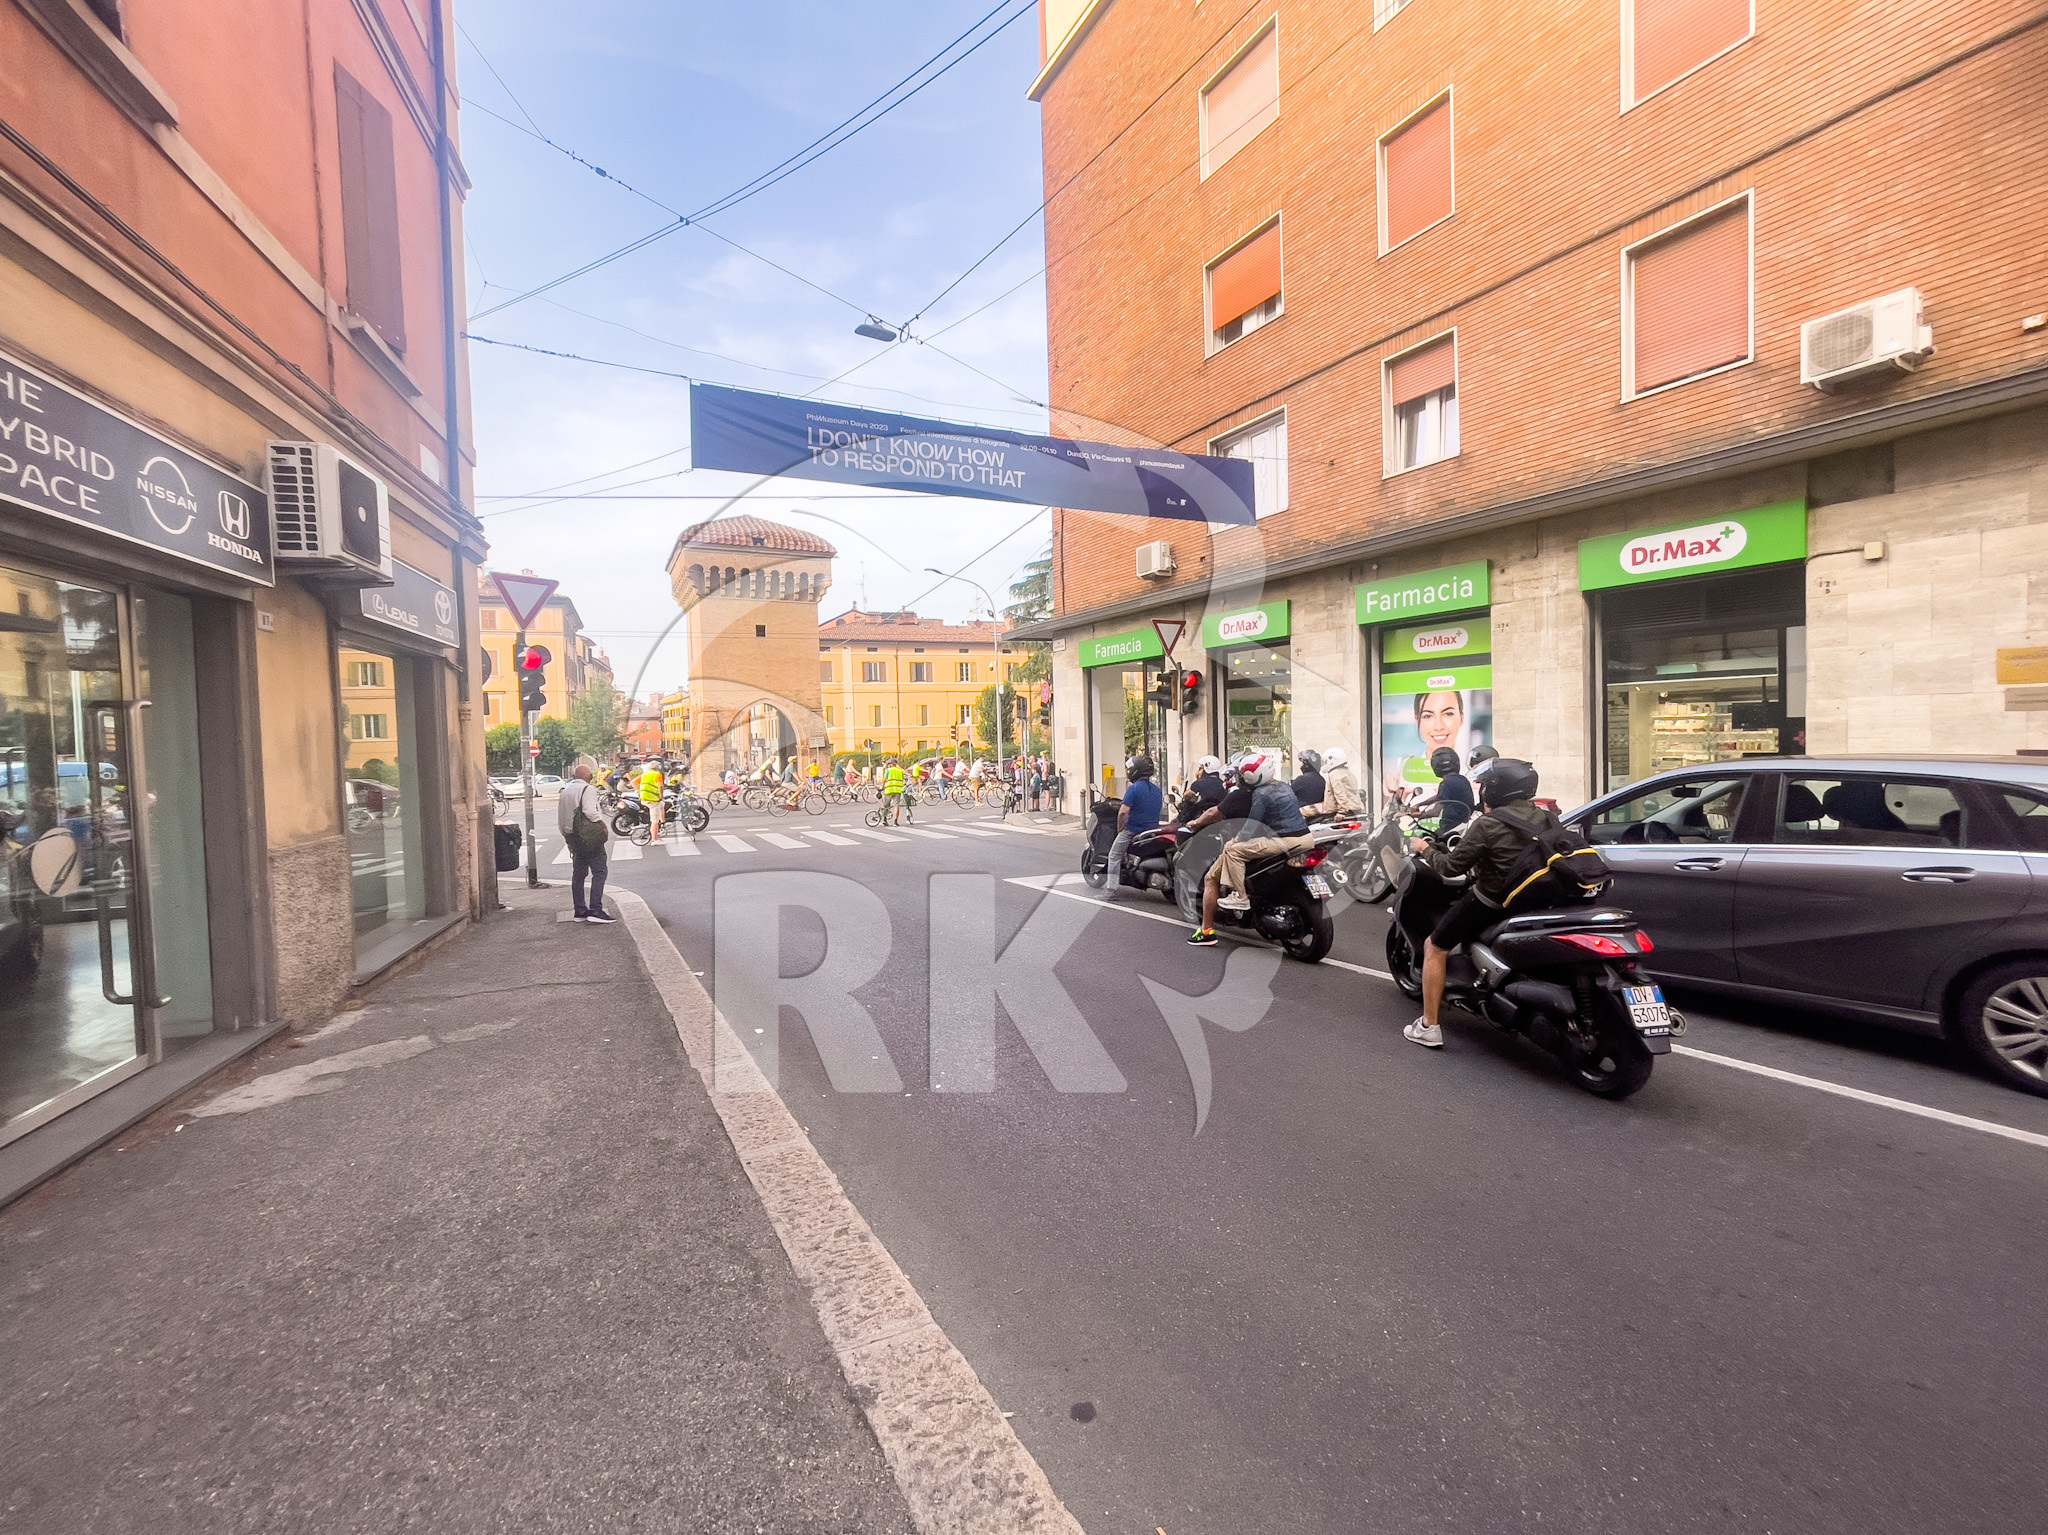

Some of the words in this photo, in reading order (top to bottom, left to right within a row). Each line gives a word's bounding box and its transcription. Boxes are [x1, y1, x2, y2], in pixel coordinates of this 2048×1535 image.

[806, 413, 849, 426] PhMuseum
[850, 419, 868, 429] Days
[869, 423, 888, 431] 2023
[807, 426, 813, 445] I
[818, 428, 885, 453] DON'T
[889, 437, 954, 461] KNOW
[958, 446, 1005, 467] HOW
[980, 438, 1010, 449] fotografia
[807, 445, 839, 467] TO
[844, 450, 945, 479] RESPOND
[947, 462, 975, 482] TO
[977, 466, 1026, 488] THAT
[137, 476, 198, 513] NISSAN
[207, 531, 264, 565] HONDA
[1631, 537, 1722, 567] Dr.Max
[1366, 575, 1473, 614] Farmacia
[384, 603, 419, 628] LEXUS
[1222, 619, 1259, 635] Dr.Max
[1095, 638, 1142, 659] Farmacia
[1419, 635, 1458, 649] Dr.Max
[1633, 988, 1648, 1003] DV
[1633, 1007, 1668, 1023] 53076
